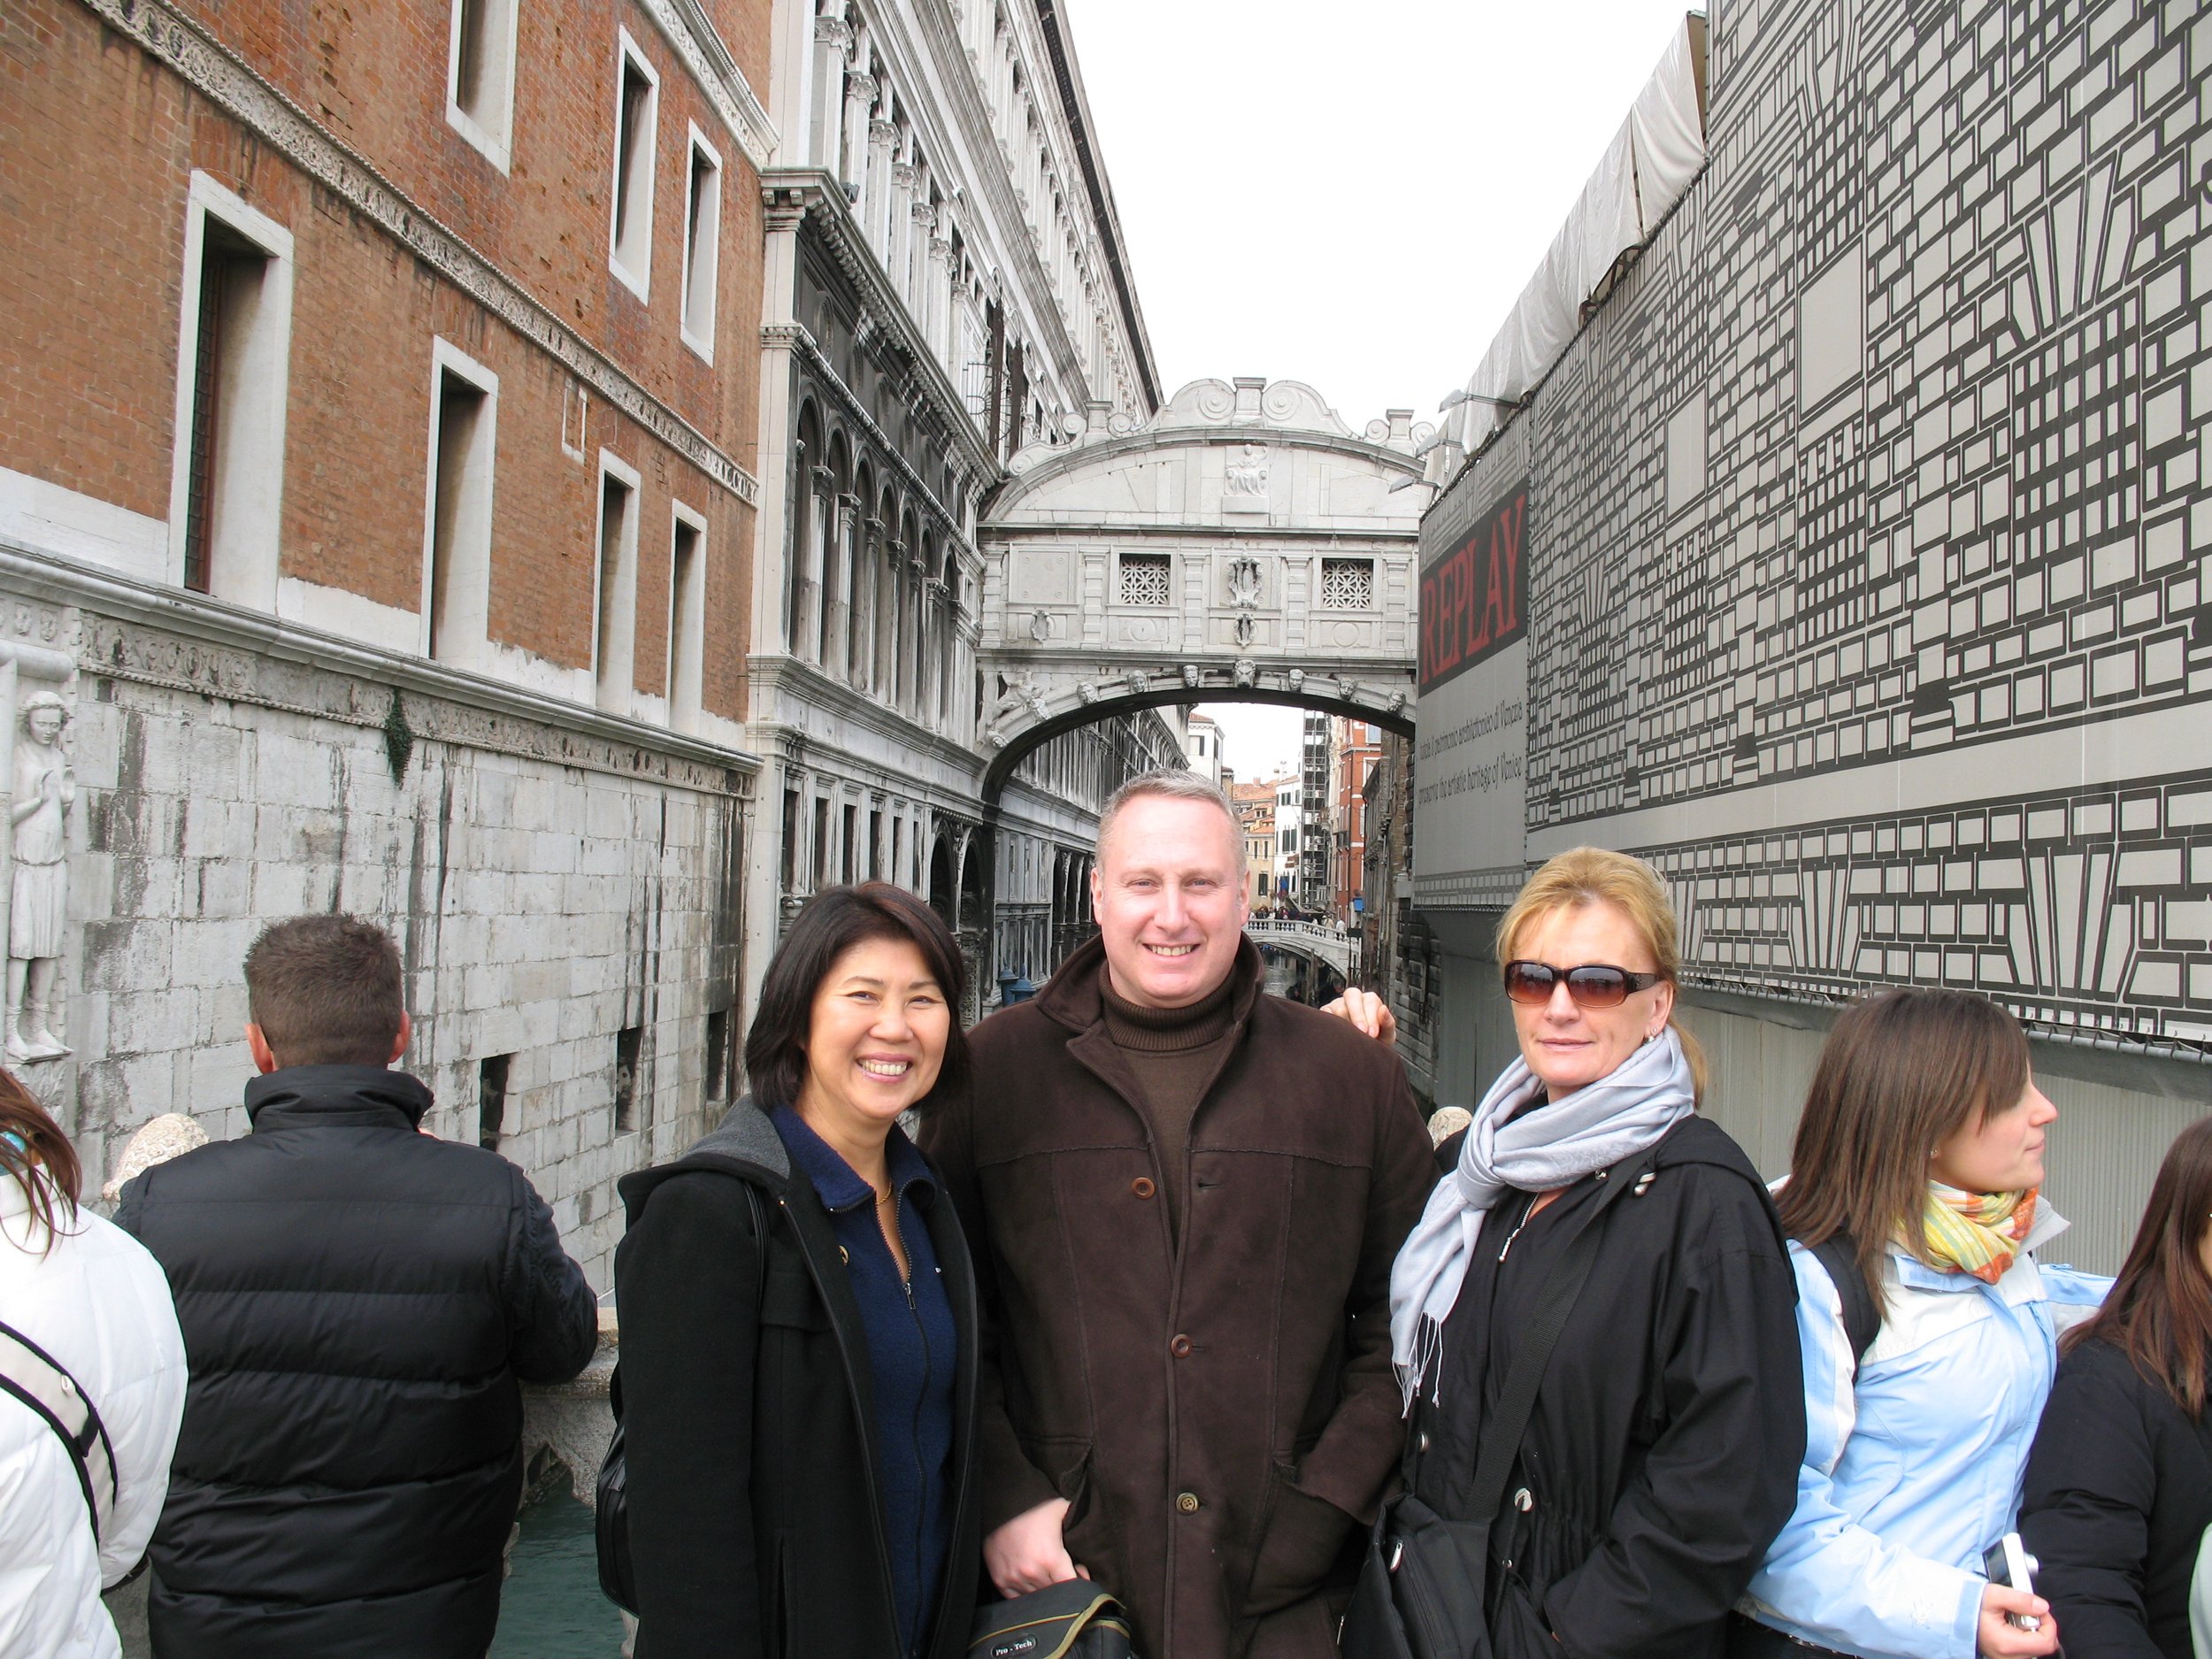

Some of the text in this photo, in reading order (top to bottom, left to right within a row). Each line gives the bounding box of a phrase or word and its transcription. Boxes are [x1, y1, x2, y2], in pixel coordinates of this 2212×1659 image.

[1420, 494, 1525, 685] REPLAY
[1501, 696, 1522, 727] Venezia
[1468, 764, 1491, 794] heritage
[1493, 756, 1499, 789] of
[1501, 752, 1522, 780] Venice
[1014, 1640, 1033, 1650] Tech
